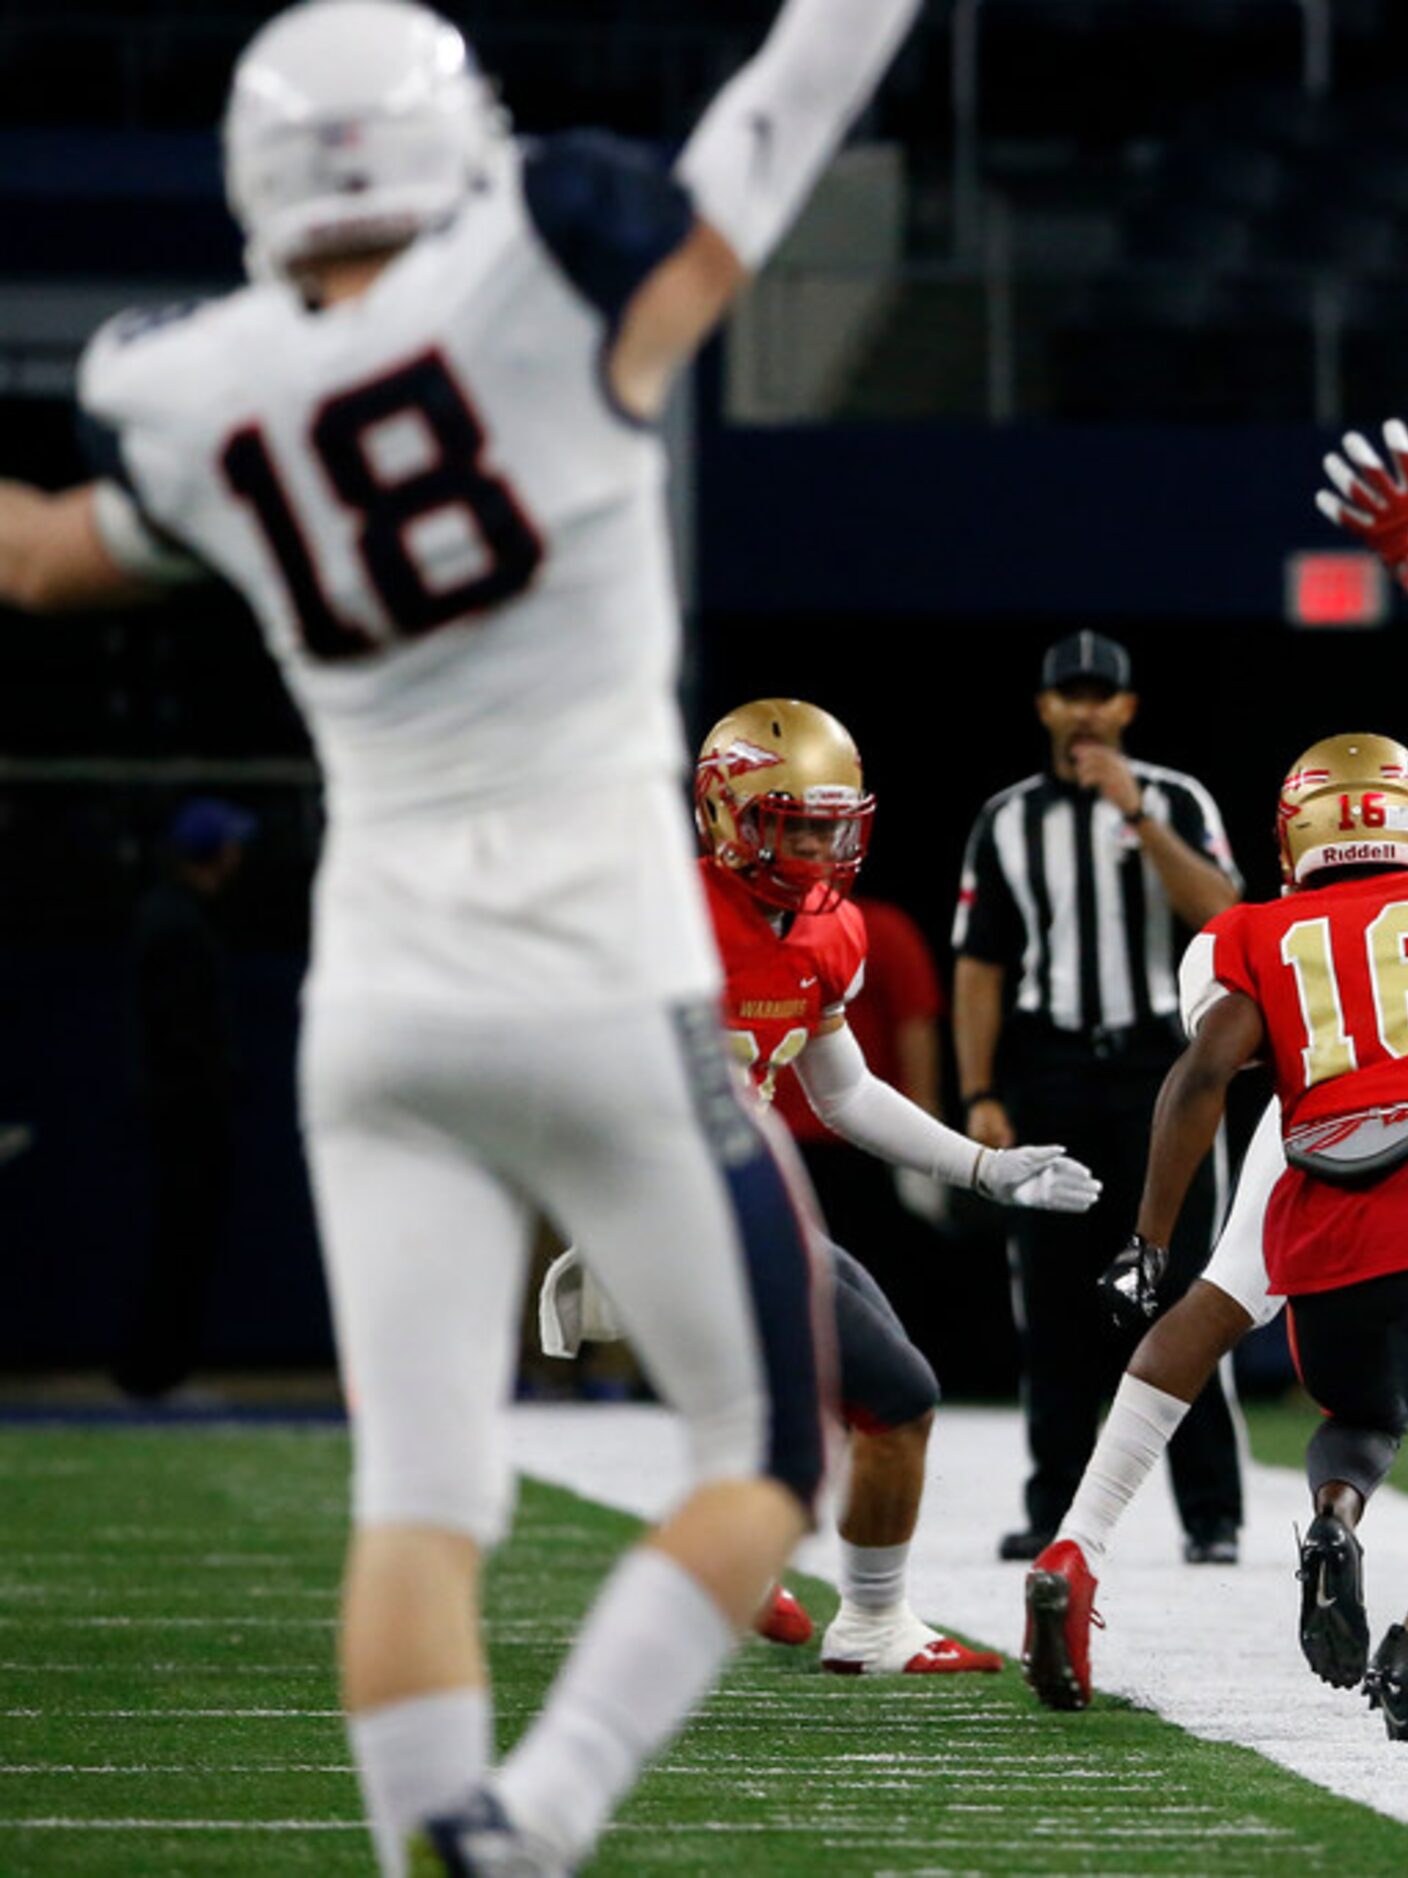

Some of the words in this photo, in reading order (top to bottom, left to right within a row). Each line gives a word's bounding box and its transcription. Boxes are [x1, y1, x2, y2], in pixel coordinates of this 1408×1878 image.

[217, 340, 546, 664] 18
[1338, 792, 1386, 831] 16
[1323, 843, 1397, 864] Riddell
